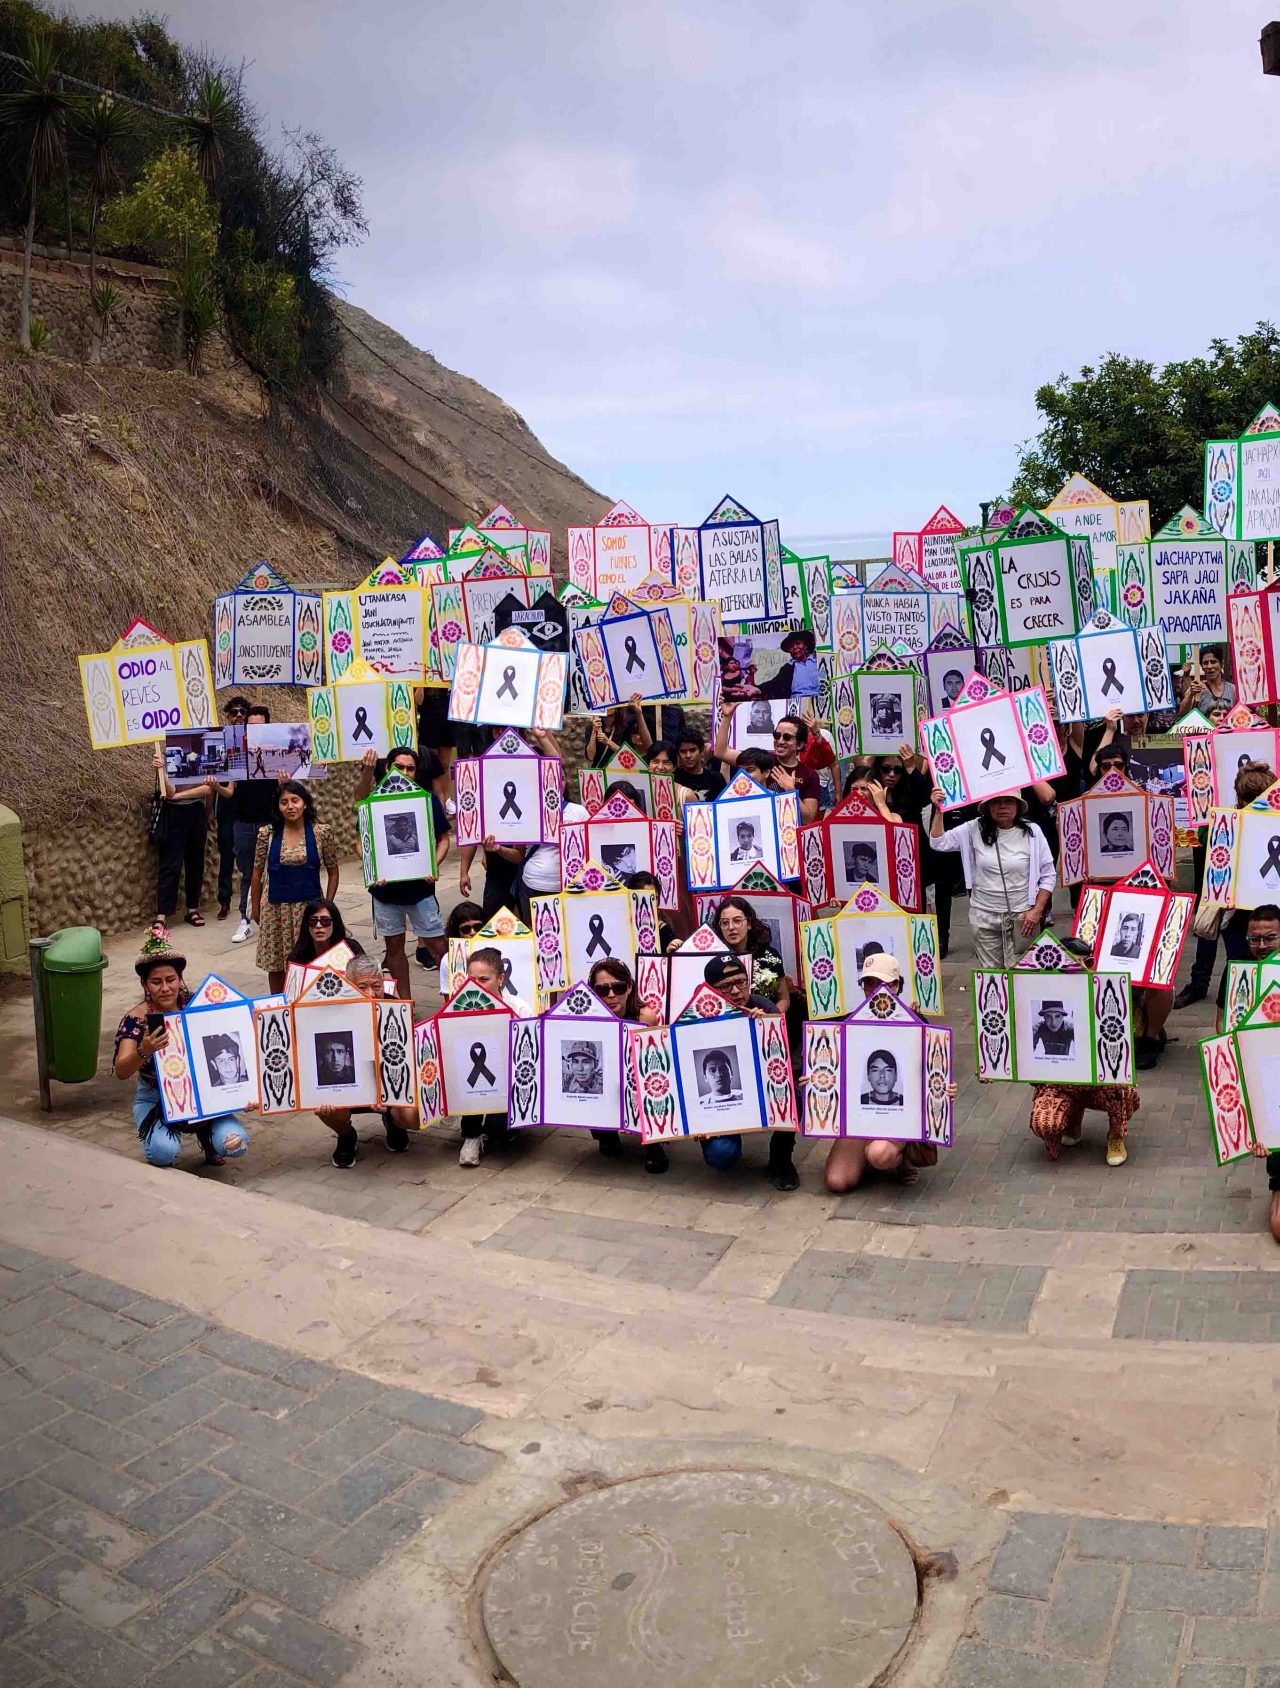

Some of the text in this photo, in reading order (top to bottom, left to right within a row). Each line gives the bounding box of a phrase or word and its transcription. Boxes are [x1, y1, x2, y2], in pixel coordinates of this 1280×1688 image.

[1056, 514, 1102, 528] EL ANDE
[602, 535, 628, 552] SOMOS
[712, 530, 759, 548] ASUSTAN
[1092, 531, 1117, 543] AMOR
[709, 549, 759, 568] LAS BALAS
[1001, 556, 1018, 574] LA
[1155, 550, 1224, 566] JACHAPXTWA
[709, 566, 763, 588] ATERRA LA
[952, 579, 964, 589] LOS
[1017, 569, 1061, 590] CRISIS
[1162, 569, 1219, 586] SAPA JAQI
[1010, 595, 1052, 609] ES PARA
[1164, 586, 1217, 605] JAKAÑA
[237, 614, 291, 627] ASAMBLEA
[866, 611, 926, 622] VISTO TANTOS
[1023, 613, 1065, 631] CRECER
[1159, 614, 1222, 634] APAQATATA
[866, 624, 919, 635] VALIENTES
[118, 659, 173, 680] ODIO AL
[121, 681, 161, 708] REVÉS
[127, 707, 181, 732] ES OIDO
